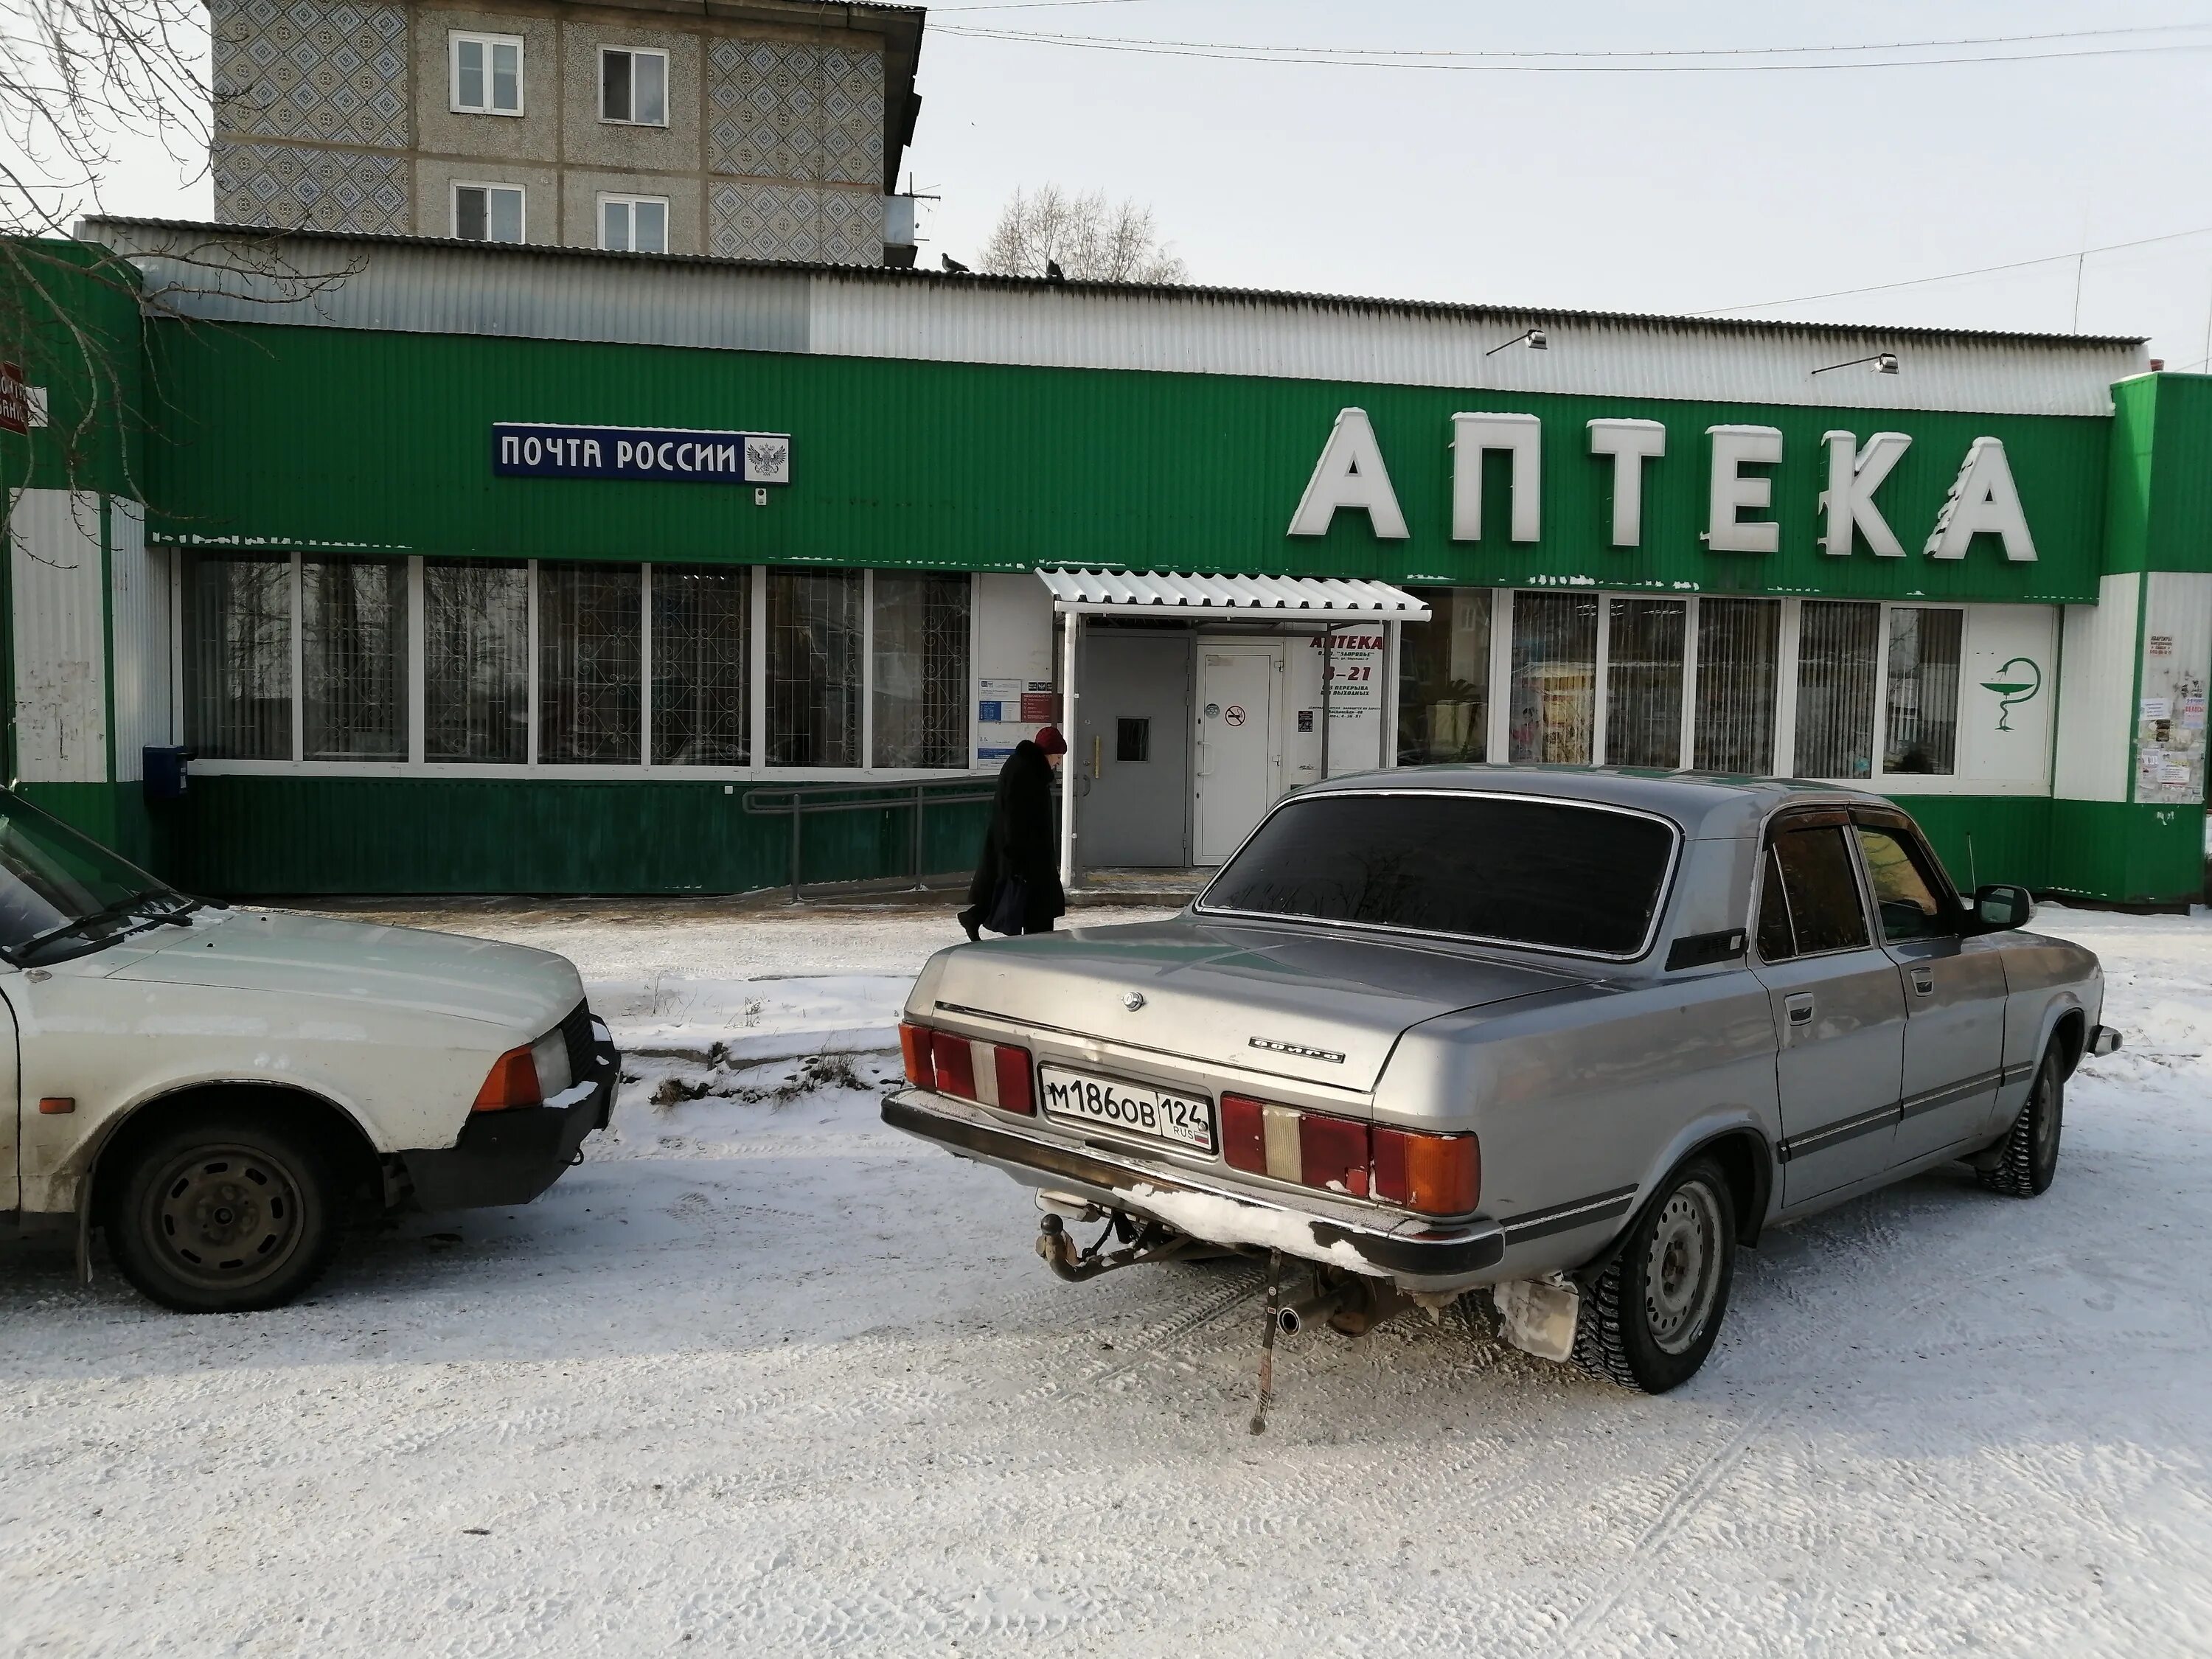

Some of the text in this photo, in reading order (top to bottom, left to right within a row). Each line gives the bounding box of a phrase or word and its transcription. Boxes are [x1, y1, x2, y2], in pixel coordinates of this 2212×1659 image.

[502, 437, 736, 472] ПОЧТА РОССИИ
[1288, 408, 2039, 562] АПТЕКА
[1051, 1079, 1208, 1130] М186ОВ 124
[1173, 1126, 1194, 1140] RUS
